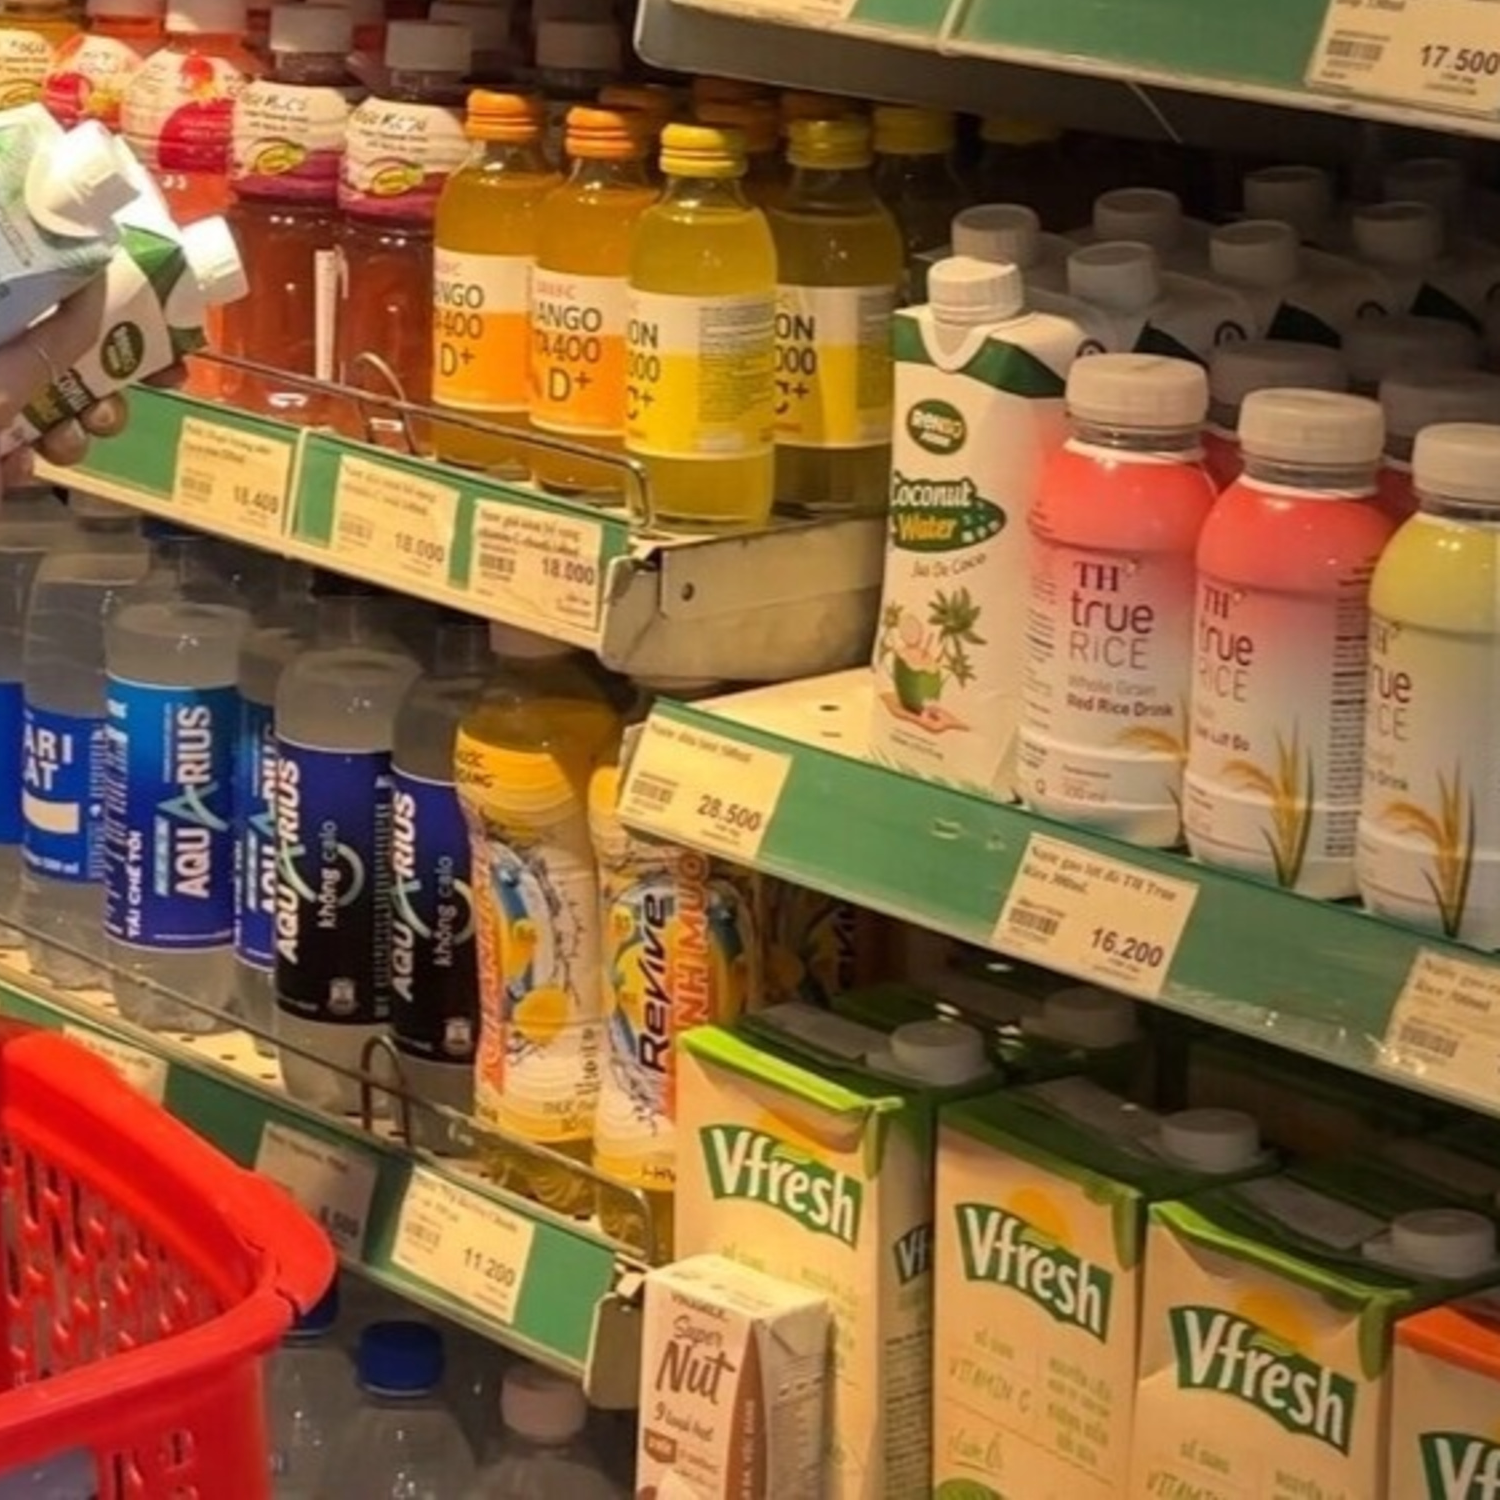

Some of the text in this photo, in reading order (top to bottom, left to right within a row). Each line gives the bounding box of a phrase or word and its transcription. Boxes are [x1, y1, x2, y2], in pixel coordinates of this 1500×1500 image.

[1419, 44, 1500, 75] 17.500
[548, 366, 593, 402] D+
[541, 556, 595, 586] 18.000
[1074, 560, 1119, 592] TH
[1071, 590, 1154, 635] true
[1067, 693, 1174, 717] Red Rice Drink
[164, 704, 224, 900] AQUARIUS
[696, 793, 763, 832] 28.500
[275, 758, 302, 967] AQUARIUS
[316, 819, 339, 931] không calo
[390, 791, 417, 1001] AQUARIUS
[432, 854, 457, 968] không calo
[1091, 927, 1165, 968] 16.200
[711, 1127, 856, 1245] Vfresh
[463, 1246, 517, 1289] 11.200
[962, 1204, 1107, 1339] Vfresh
[673, 1314, 724, 1348] Super
[655, 1339, 737, 1406] Nut
[1182, 1308, 1350, 1456] Vfresh
